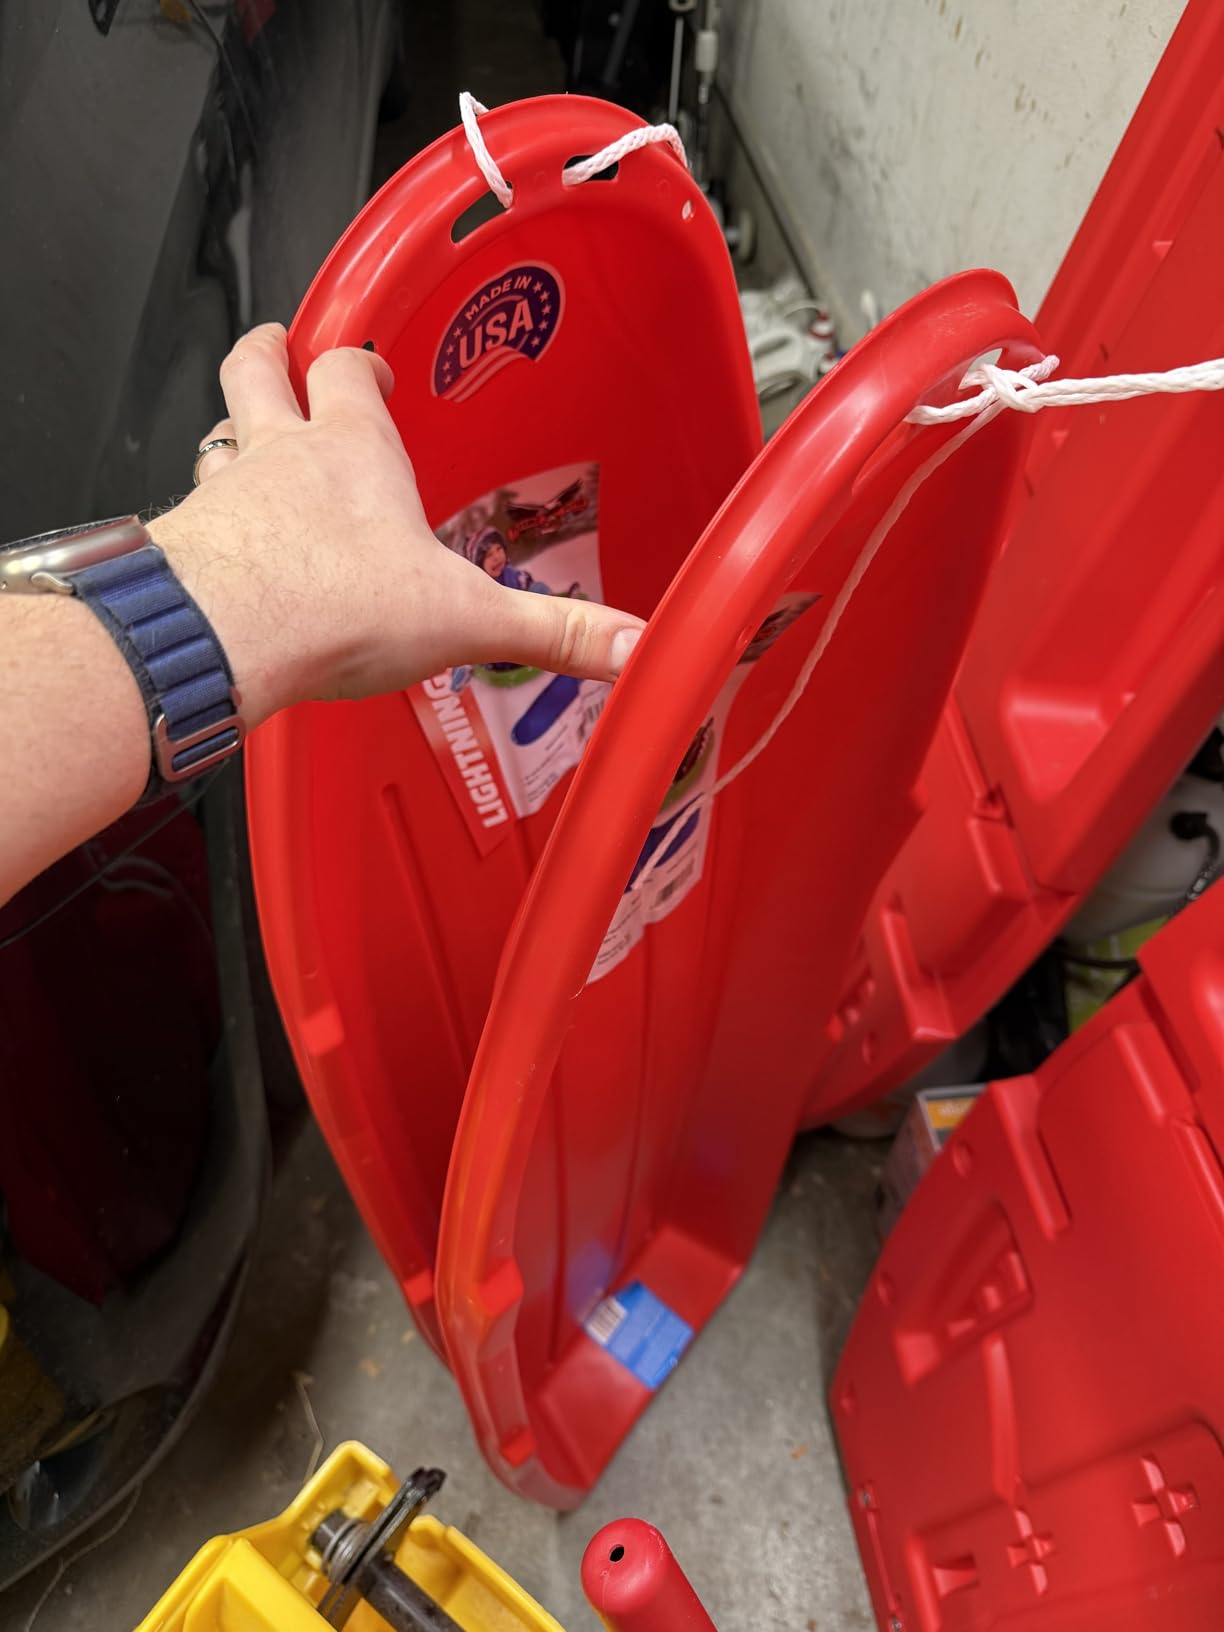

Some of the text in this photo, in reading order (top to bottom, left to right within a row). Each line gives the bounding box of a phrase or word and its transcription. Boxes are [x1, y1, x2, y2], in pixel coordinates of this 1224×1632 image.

[464, 275, 532, 320] MADE IN
[459, 298, 534, 369] USA
[422, 668, 509, 828] LIGHTNING
